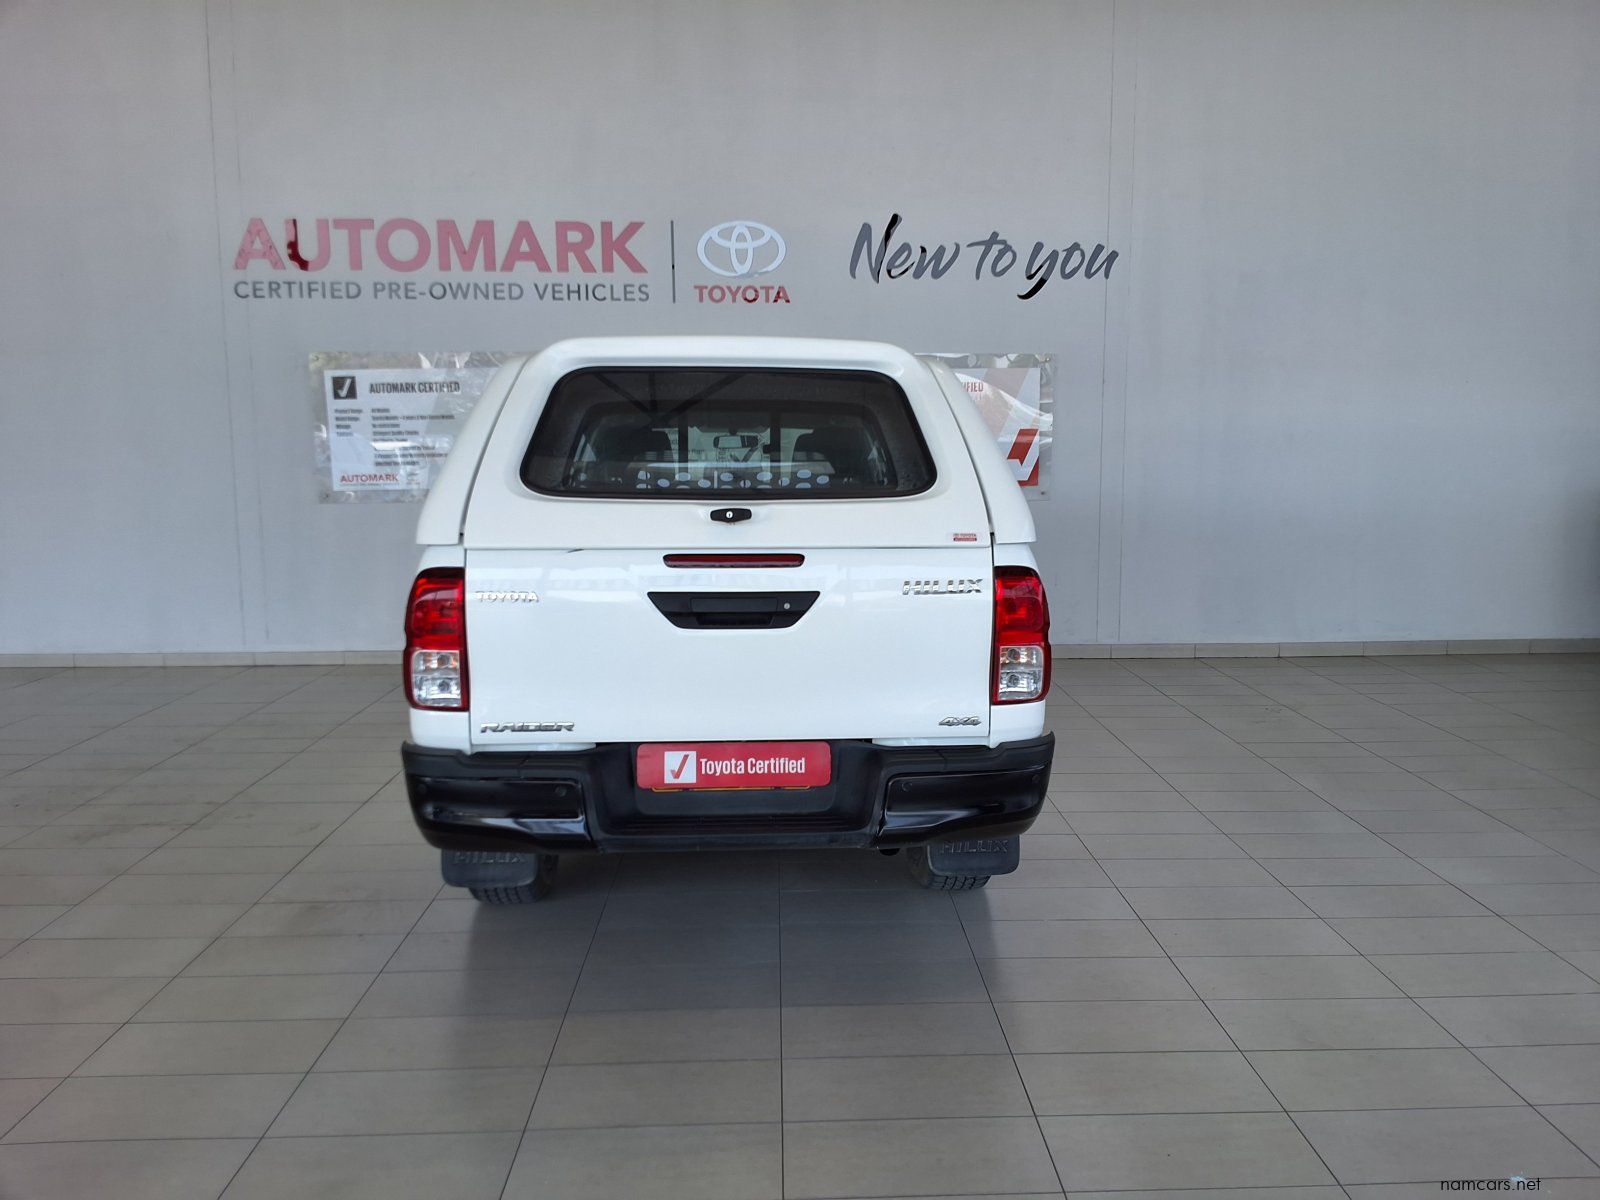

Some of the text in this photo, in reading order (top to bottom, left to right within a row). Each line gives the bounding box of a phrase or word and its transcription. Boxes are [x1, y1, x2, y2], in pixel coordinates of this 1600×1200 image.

[232, 217, 648, 275] AUTOMARK
[850, 213, 1119, 300] New to you
[233, 280, 650, 303] CERTIFIED PRE-OWNED VEHICLES
[694, 284, 791, 304] TOYOTA
[369, 381, 461, 394] AUTOMARK CERTIFIED
[340, 473, 399, 483] AUTOMARK
[902, 579, 983, 595] HILUX
[475, 590, 539, 603] TOYOTA
[480, 722, 575, 734] RAIDER
[700, 757, 806, 776] Toyota Certified
[940, 839, 1009, 854] HILUX
